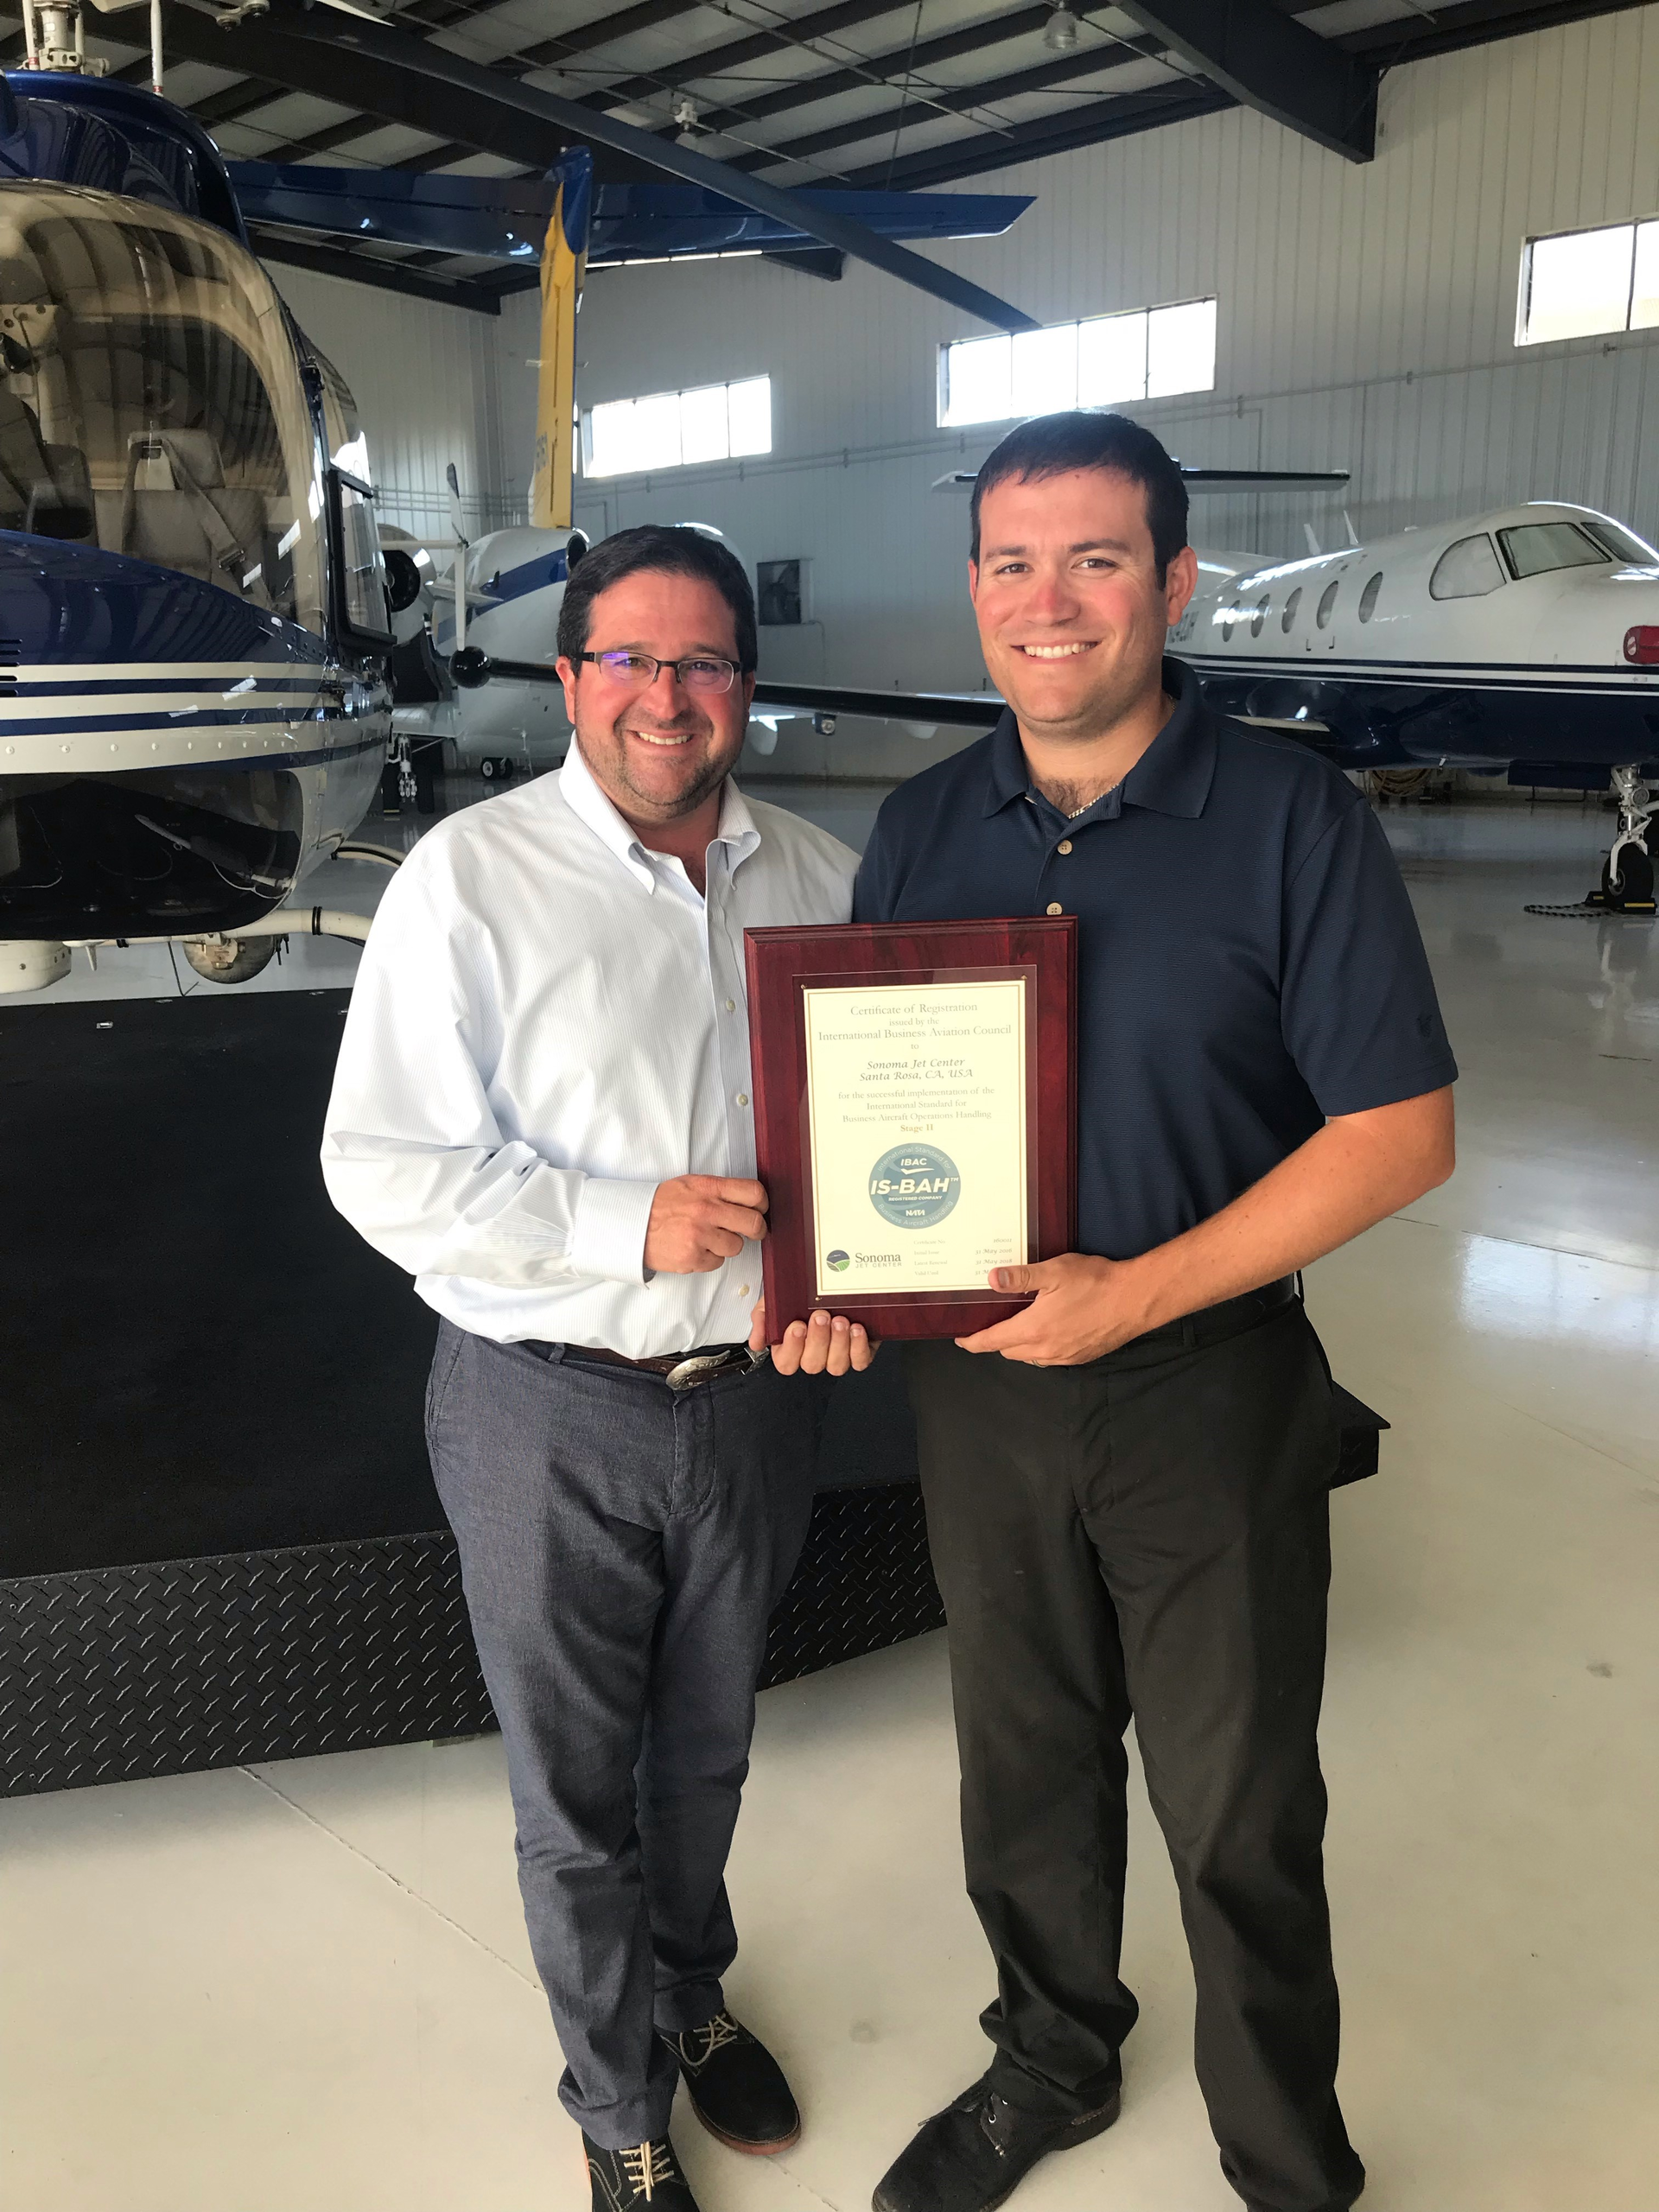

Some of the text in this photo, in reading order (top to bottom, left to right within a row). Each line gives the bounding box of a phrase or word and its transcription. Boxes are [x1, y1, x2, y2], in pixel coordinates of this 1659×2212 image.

[851, 1002, 977, 1015] Certificate of Registration
[916, 1017, 925, 1027] by
[818, 1025, 1011, 1041] International Business Aviation Council
[867, 1058, 965, 1070] Sonoma Jet Center
[860, 1069, 973, 1081] Santa Rosa, CA, USA
[867, 1090, 906, 1098] successful
[907, 1088, 968, 1098] implementation
[867, 1101, 916, 1110] International
[918, 1100, 953, 1109] Standard
[879, 1113, 908, 1122] Aircraft
[910, 1112, 953, 1122] Operations
[956, 1110, 992, 1120] Handling
[900, 1124, 924, 1134] Stage
[878, 1147, 951, 1172] International Standard for
[870, 1178, 950, 1195] IS-BAH
[878, 1200, 954, 1226] Business Aircraft Handling
[855, 1253, 901, 1263] Sonoma
